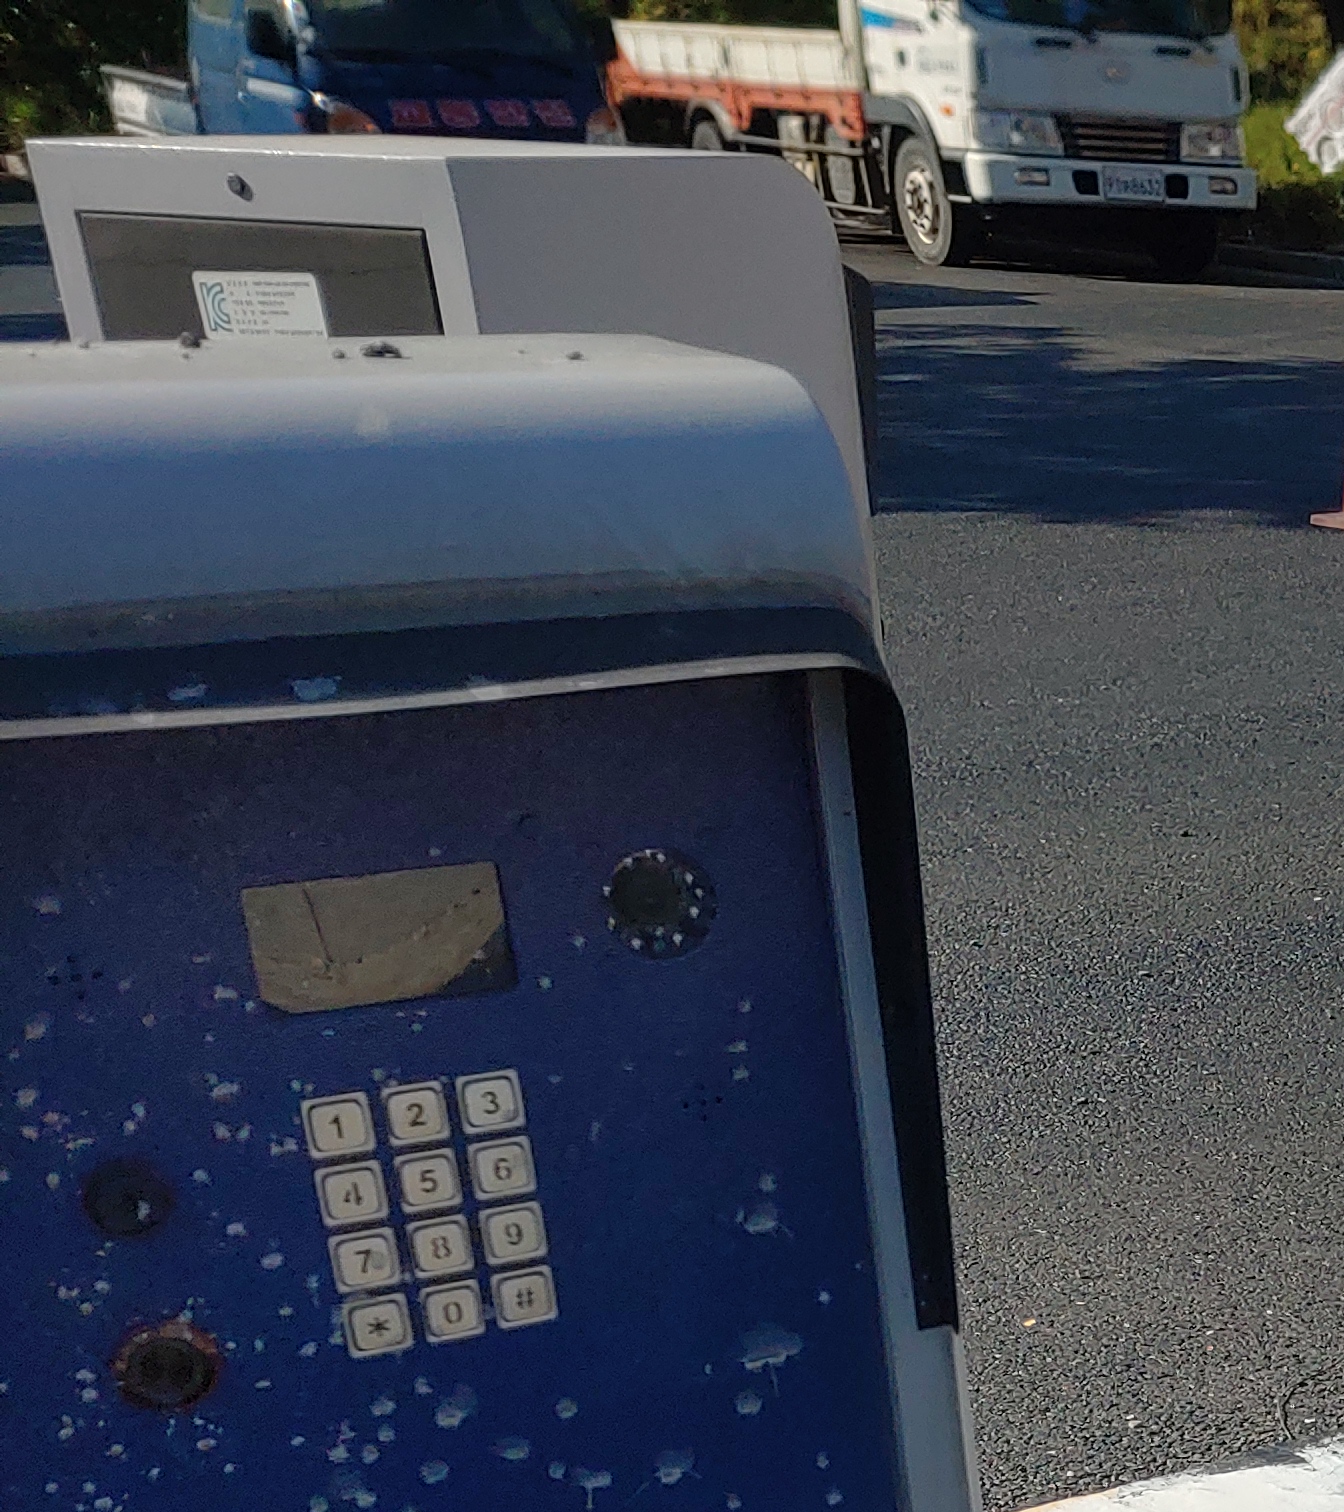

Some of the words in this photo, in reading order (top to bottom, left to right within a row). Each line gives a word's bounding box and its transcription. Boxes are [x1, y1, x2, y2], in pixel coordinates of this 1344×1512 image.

[327, 1114, 344, 1139] 1
[406, 1102, 427, 1127] 2
[480, 1090, 500, 1115] 3
[342, 1181, 363, 1206] 4
[419, 1168, 438, 1194] 5
[493, 1157, 513, 1182] 6
[354, 1248, 371, 1274] 7
[430, 1234, 453, 1261] 8
[504, 1221, 524, 1246] 9
[442, 1300, 463, 1325] 0
